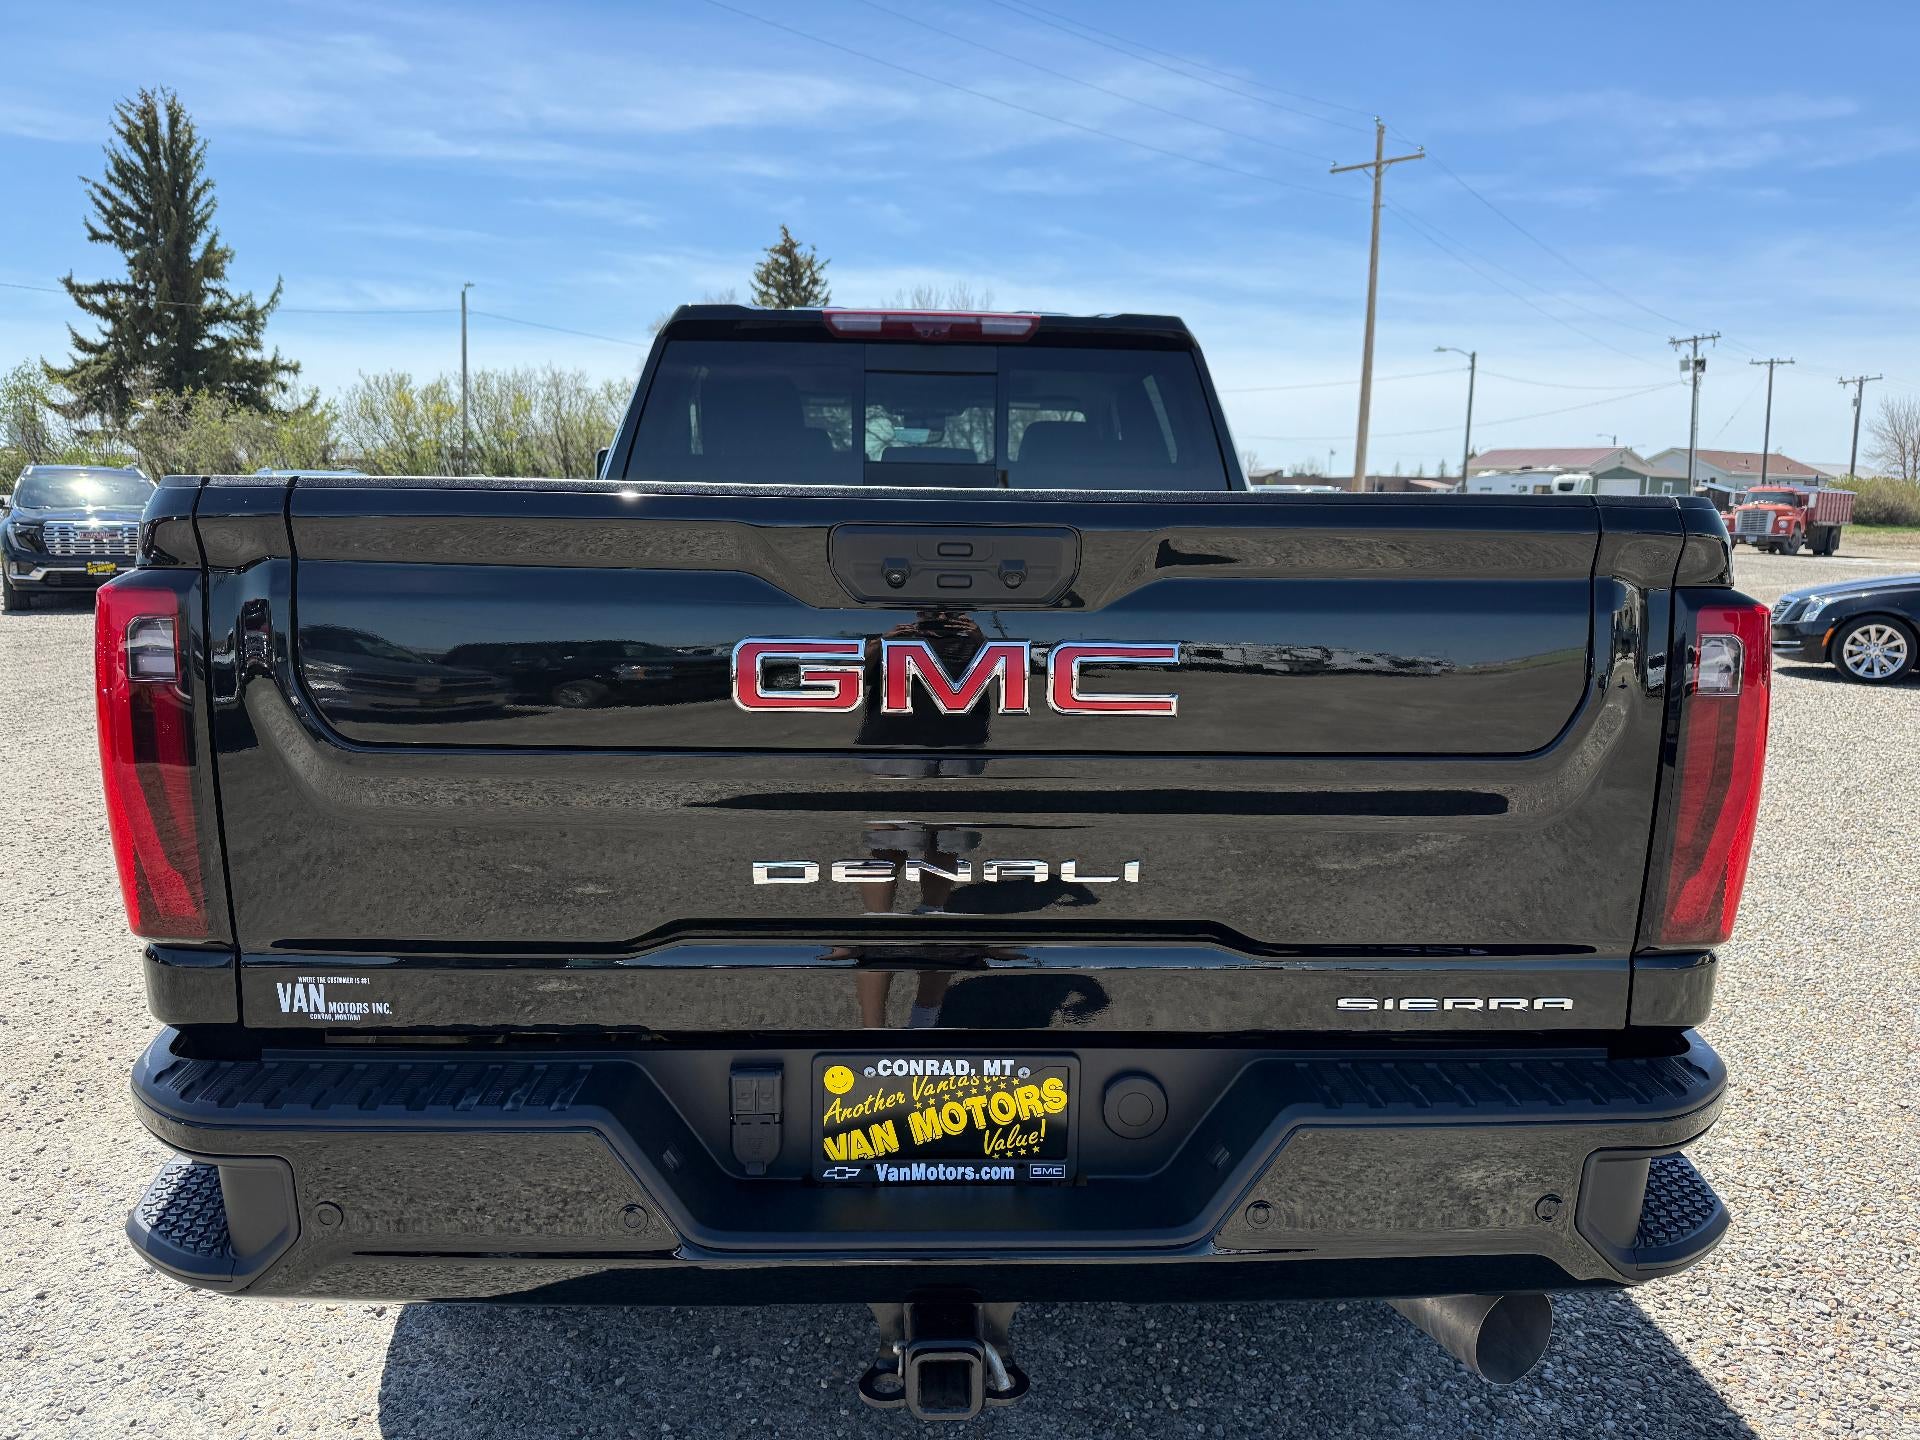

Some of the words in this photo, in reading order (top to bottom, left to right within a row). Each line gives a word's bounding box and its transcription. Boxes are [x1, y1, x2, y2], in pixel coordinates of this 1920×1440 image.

[731, 636, 1181, 717] GMC
[752, 859, 1140, 885] DENALI
[276, 982, 326, 1013] VAN
[328, 1001, 370, 1014] MOTORS
[372, 1002, 393, 1015] INC.
[1336, 997, 1574, 1011] SIERRA
[877, 1059, 976, 1077] CONRAD,
[983, 1059, 1015, 1076] MT
[823, 1120, 900, 1160] VAN
[908, 1077, 1068, 1145] MOTORS
[824, 1088, 906, 1127] Another
[983, 1118, 1047, 1155] Value!
[876, 1163, 1015, 1182] VanMotors.com
[1032, 1167, 1063, 1176] GMC
